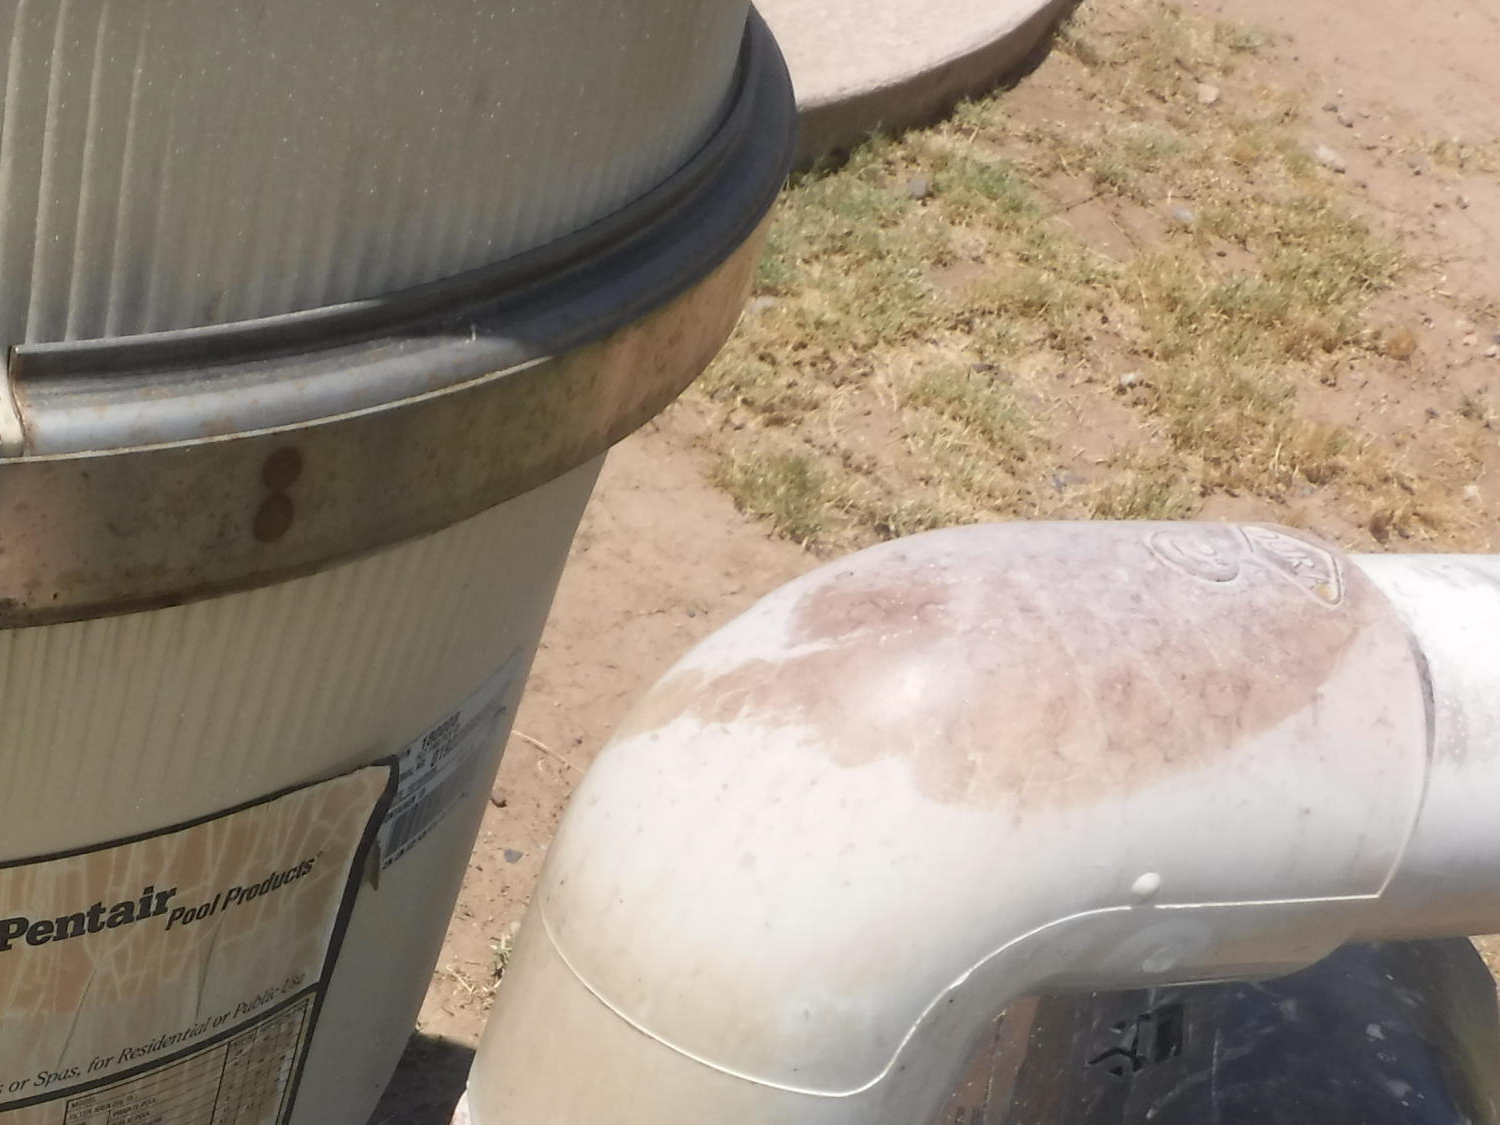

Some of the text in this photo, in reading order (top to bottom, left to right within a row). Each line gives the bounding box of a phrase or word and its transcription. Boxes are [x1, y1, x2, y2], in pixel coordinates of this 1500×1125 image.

[165, 893, 221, 931] Pool
[221, 857, 316, 913] Products
[8, 1078, 31, 1093] or
[33, 1066, 81, 1089] Spas,
[87, 1055, 113, 1075] for
[117, 1017, 212, 1064] Residential
[212, 1010, 230, 1028] or
[233, 988, 276, 1018] Public
